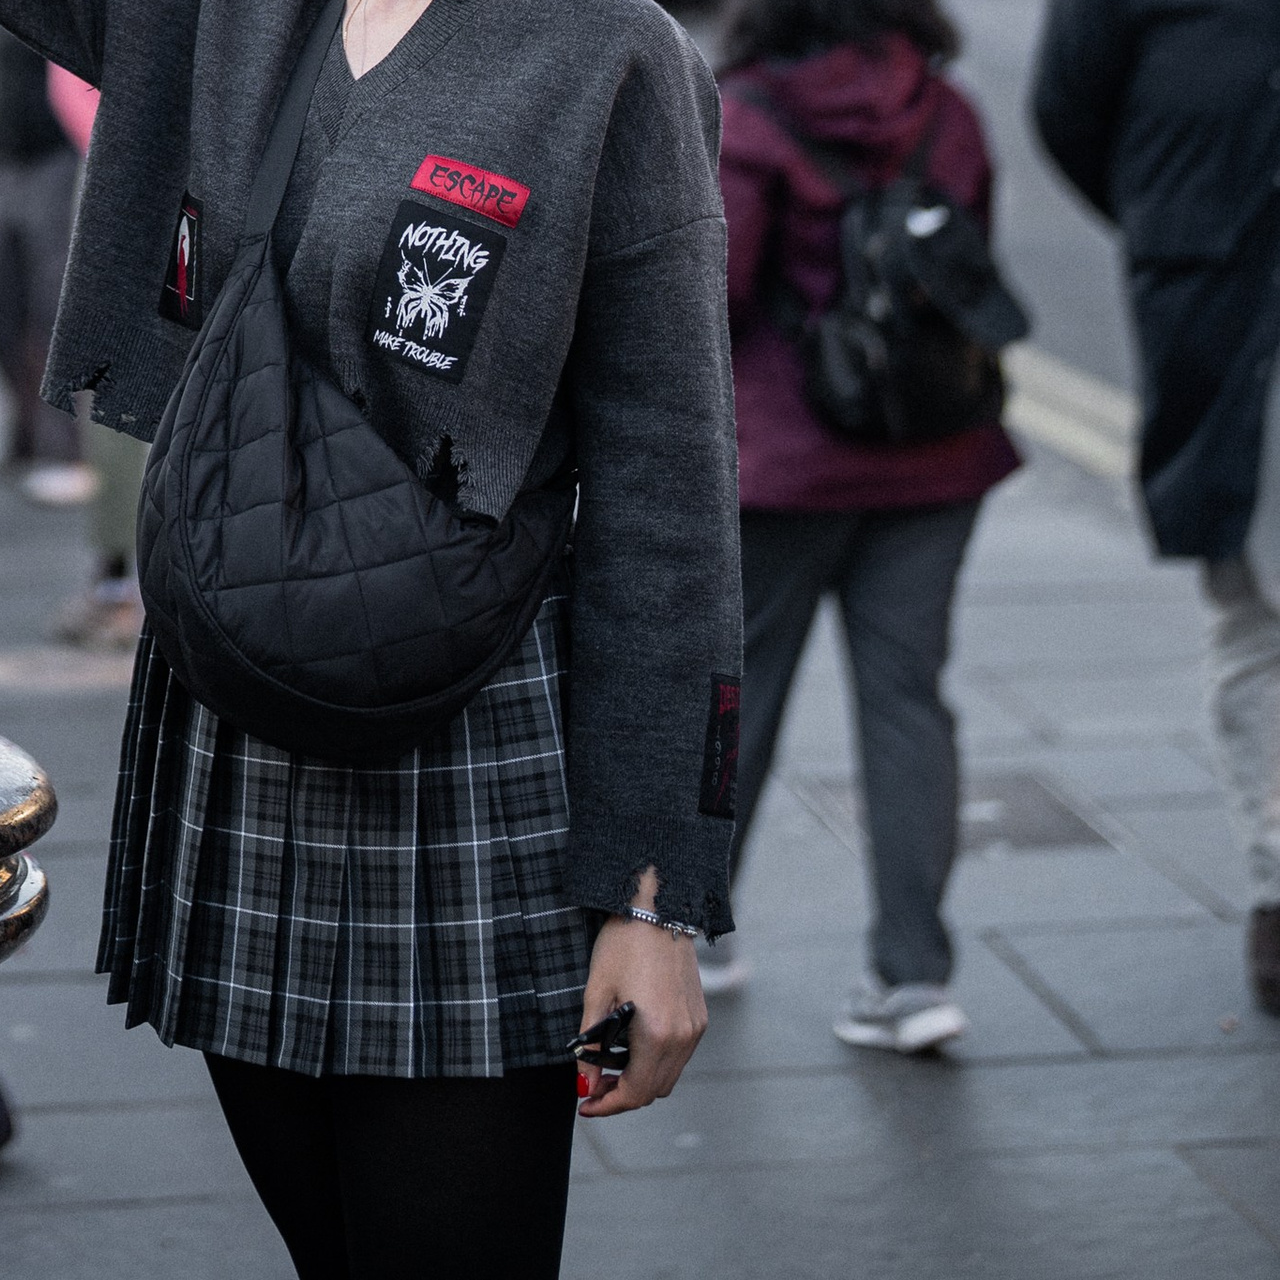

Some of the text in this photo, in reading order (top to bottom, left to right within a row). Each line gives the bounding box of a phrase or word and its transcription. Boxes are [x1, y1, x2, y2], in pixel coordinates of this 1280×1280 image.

[429, 163, 518, 215] ESCAPE
[398, 221, 490, 274] NOTHING
[373, 329, 459, 369] MAKE TROUBLE
